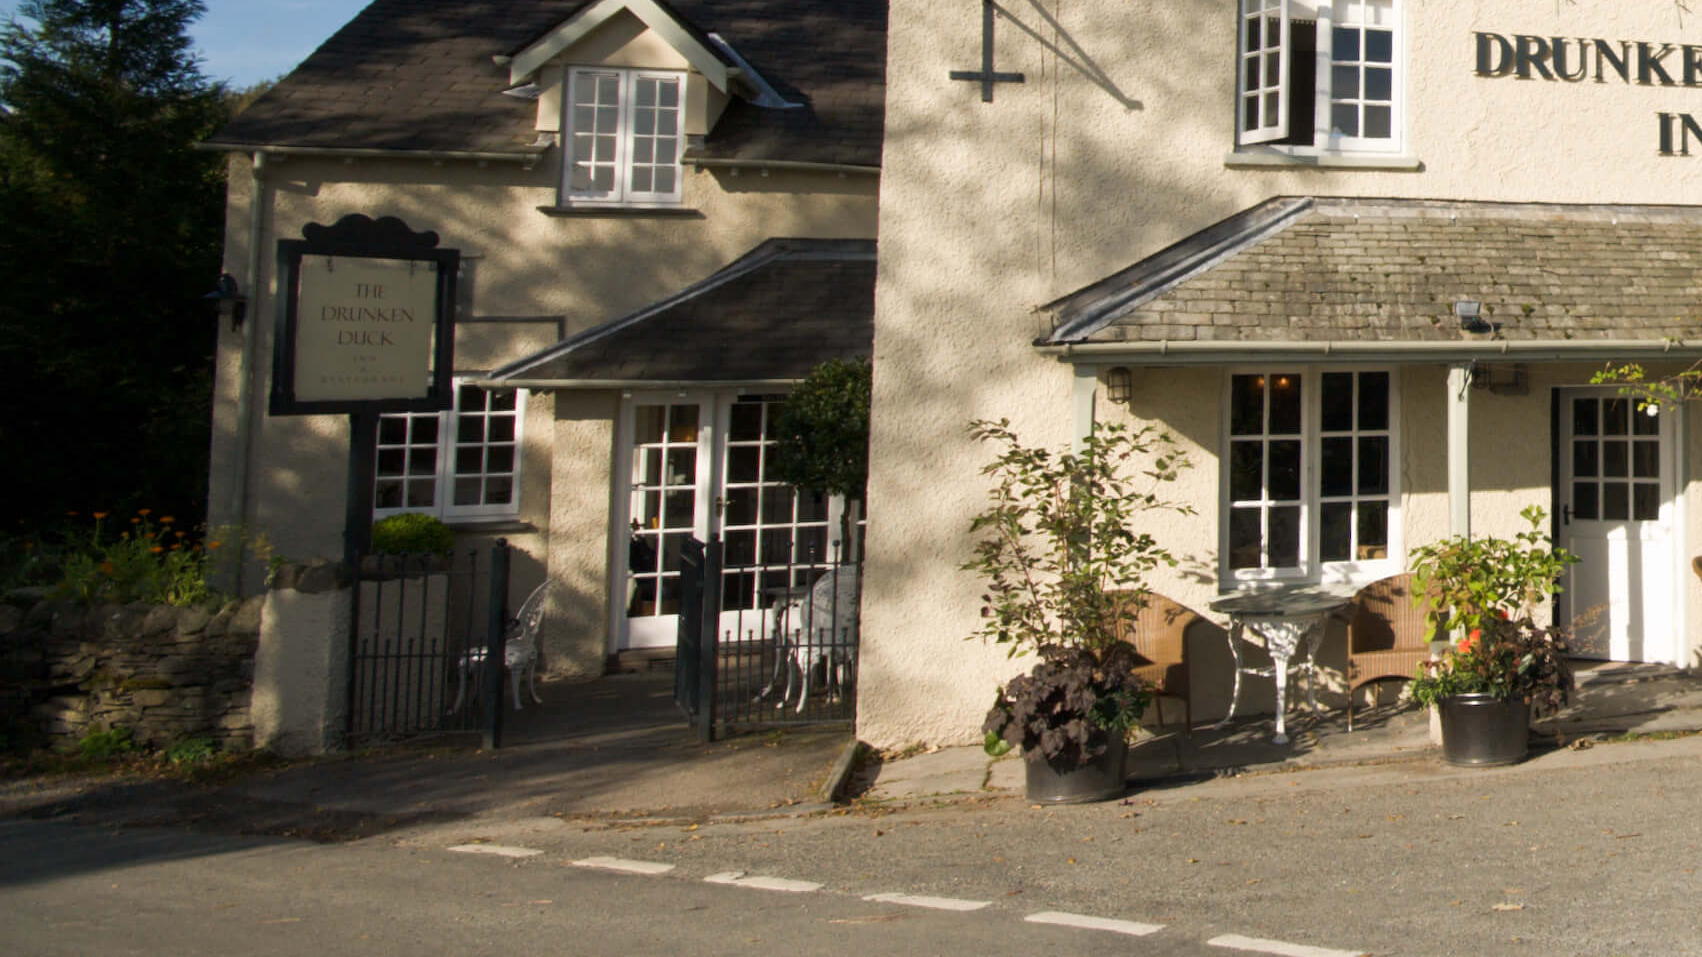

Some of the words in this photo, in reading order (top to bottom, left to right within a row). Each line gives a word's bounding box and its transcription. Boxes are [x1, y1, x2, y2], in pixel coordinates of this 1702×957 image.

[352, 283, 386, 299] THE
[320, 306, 415, 322] DRUNKEN
[337, 330, 396, 346] DUCK
